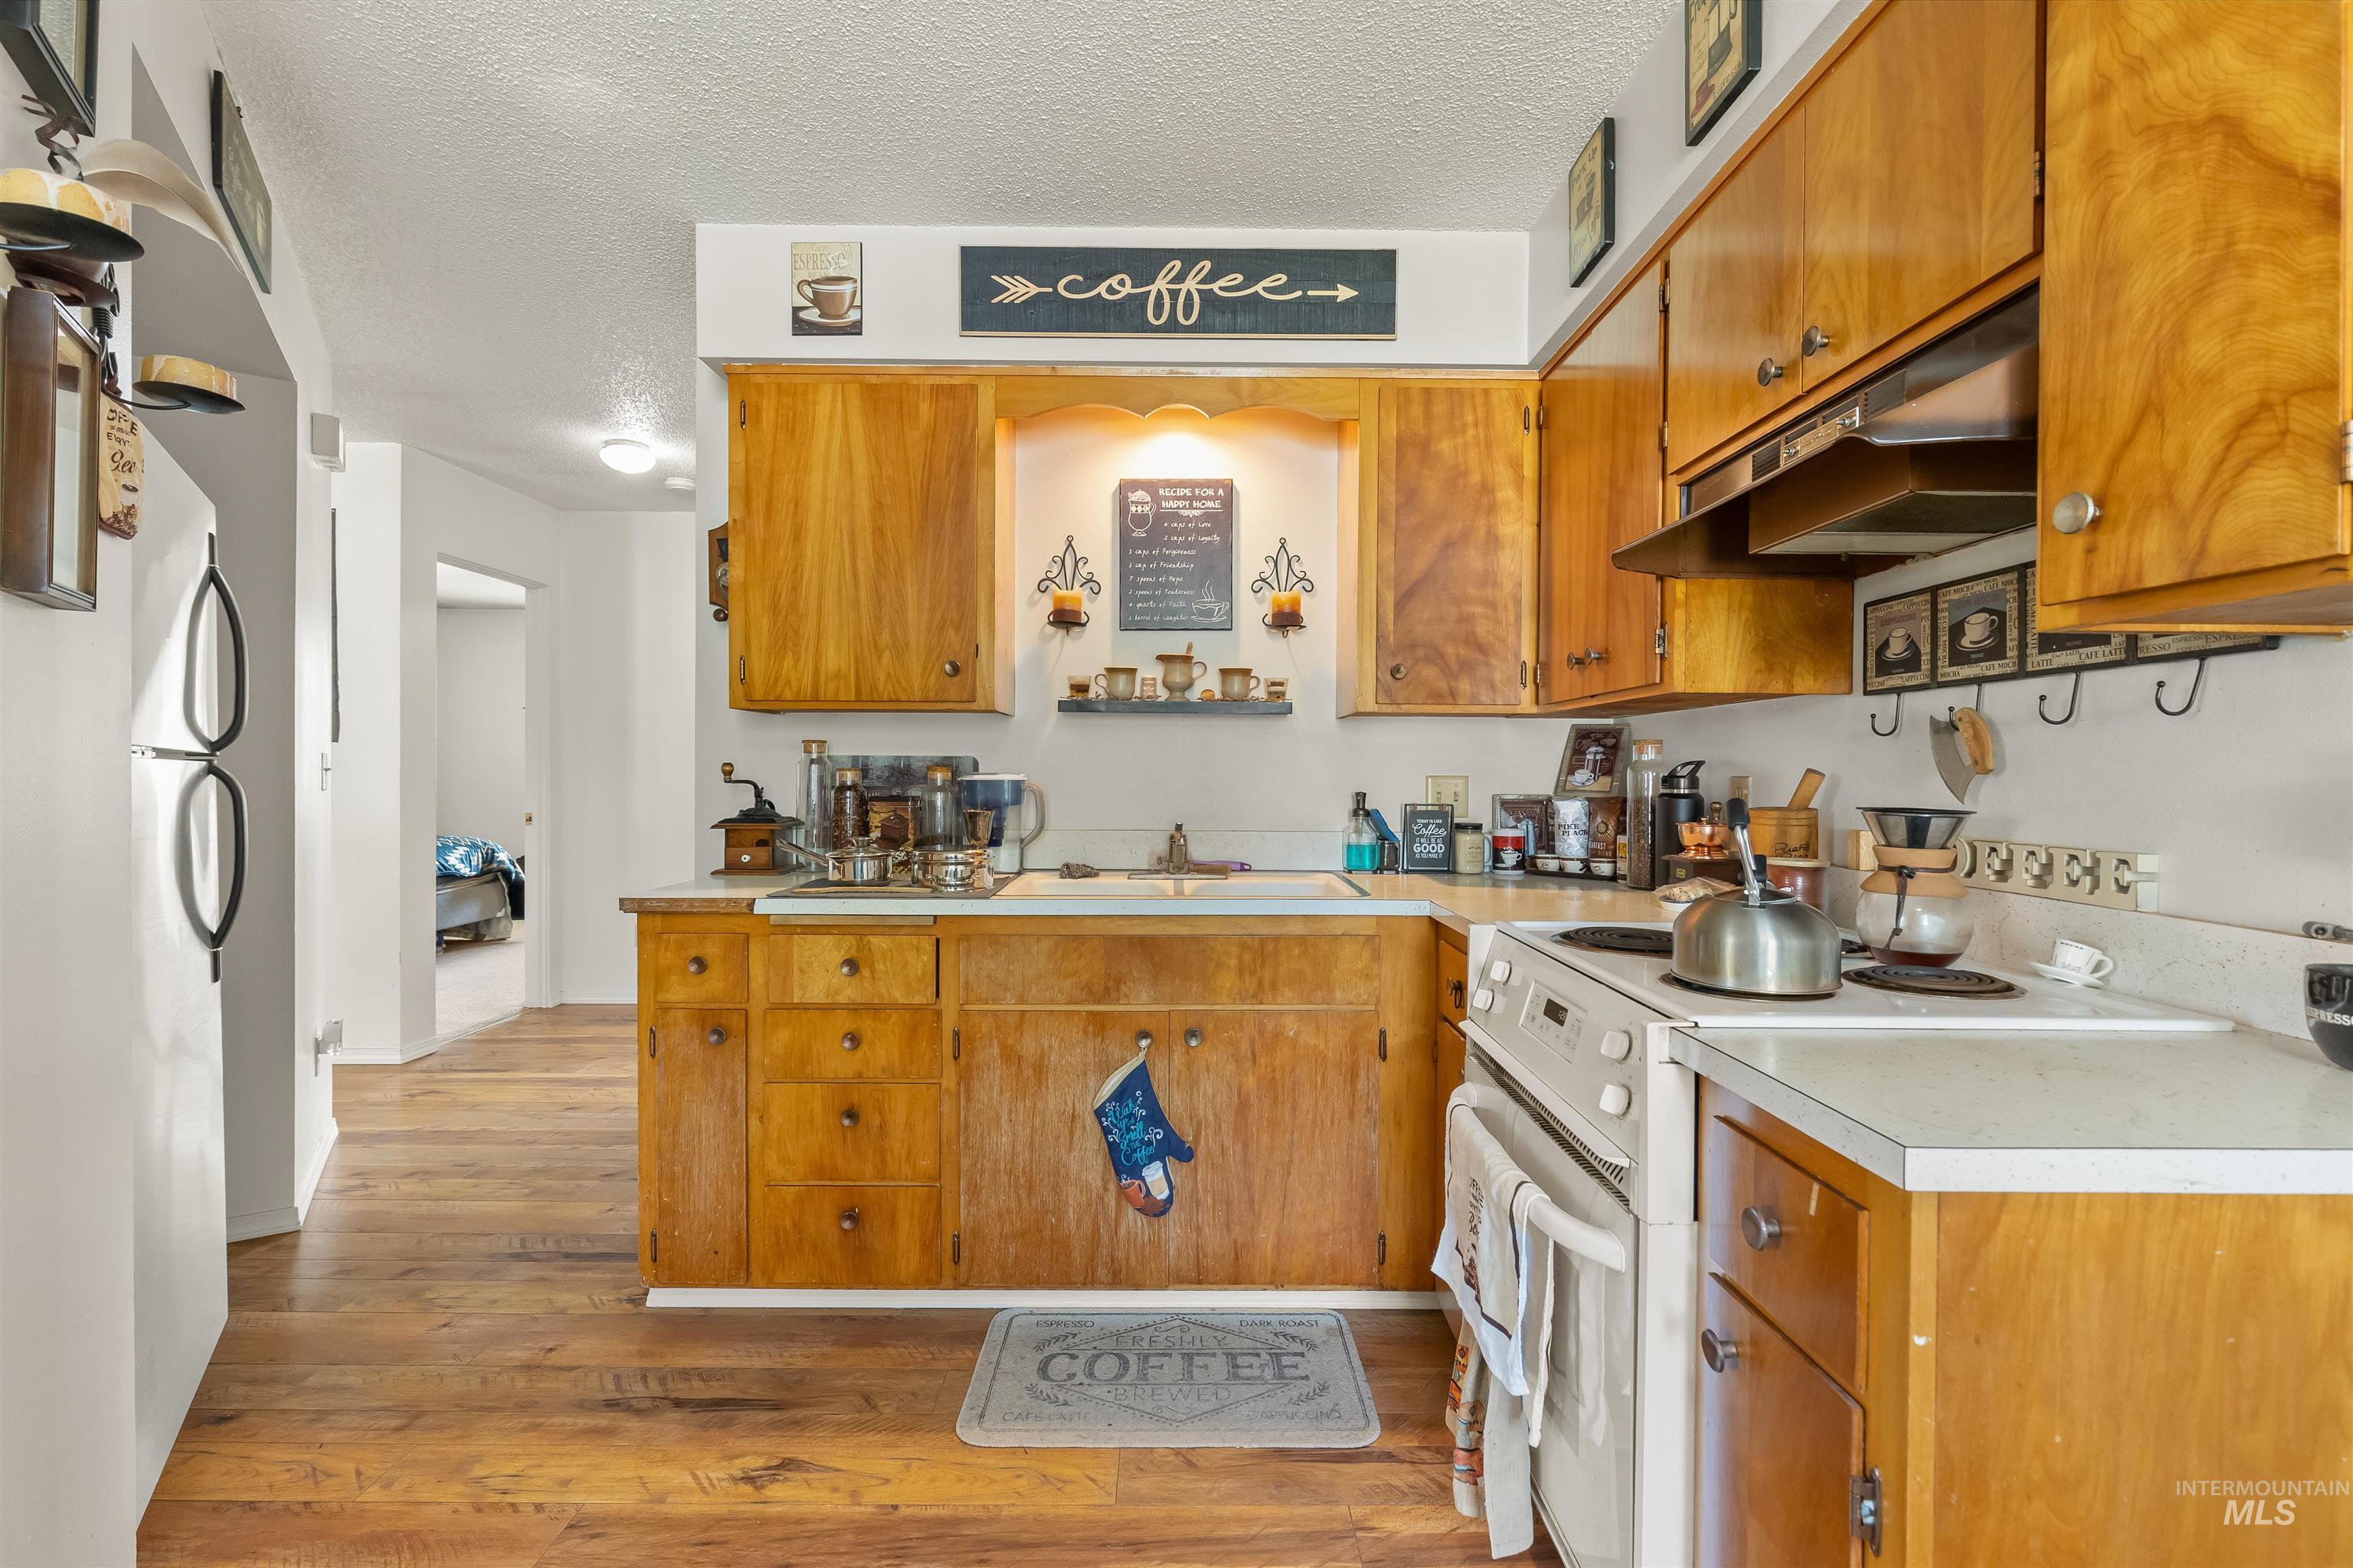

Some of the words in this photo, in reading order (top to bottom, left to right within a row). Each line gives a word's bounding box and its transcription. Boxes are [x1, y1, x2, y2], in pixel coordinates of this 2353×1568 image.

[794, 253, 846, 270] ESPRESSO
[1058, 259, 1302, 326] coffee
[1159, 488, 1192, 496] RECIPE
[1195, 488, 1214, 496] FOR
[1162, 500, 1189, 509] HAPPY
[1193, 500, 1221, 509] HOME
[1198, 534, 1220, 544] Loyalty
[1162, 548, 1196, 557] Forgiveness
[1160, 561, 1194, 571] Friendship
[1136, 577, 1156, 585] spoons
[1169, 576, 1183, 585] Hope
[1938, 590, 1952, 598] CAFE
[1953, 584, 1974, 597] MOCHA
[1984, 581, 2000, 591] CAFE
[1134, 590, 1153, 598] spoons
[1136, 601, 1156, 611] quarts
[1163, 614, 1189, 623] Laughter
[2172, 635, 2207, 644] ESPRESSO
[2079, 650, 2100, 661] CAFE
[1981, 663, 1996, 672] CAFE
[2031, 658, 2054, 669] LATTE
[1939, 670, 1960, 679] MOCHA
[1412, 823, 1447, 838] Coffee
[1413, 843, 1445, 853] GOOD
[2060, 941, 2083, 950] MOCHA
[1118, 1121, 1147, 1149] Smell
[1130, 1140, 1141, 1150] THE
[1121, 1145, 1156, 1166] Coffee
[1036, 1320, 1095, 1328] ESPRESSO
[1239, 1320, 1275, 1328] DARK
[1278, 1319, 1320, 1328] ROAST
[1115, 1335, 1227, 1348] FRESHLY
[1037, 1351, 1311, 1383] COFFEE
[1114, 1387, 1231, 1402] BREWED
